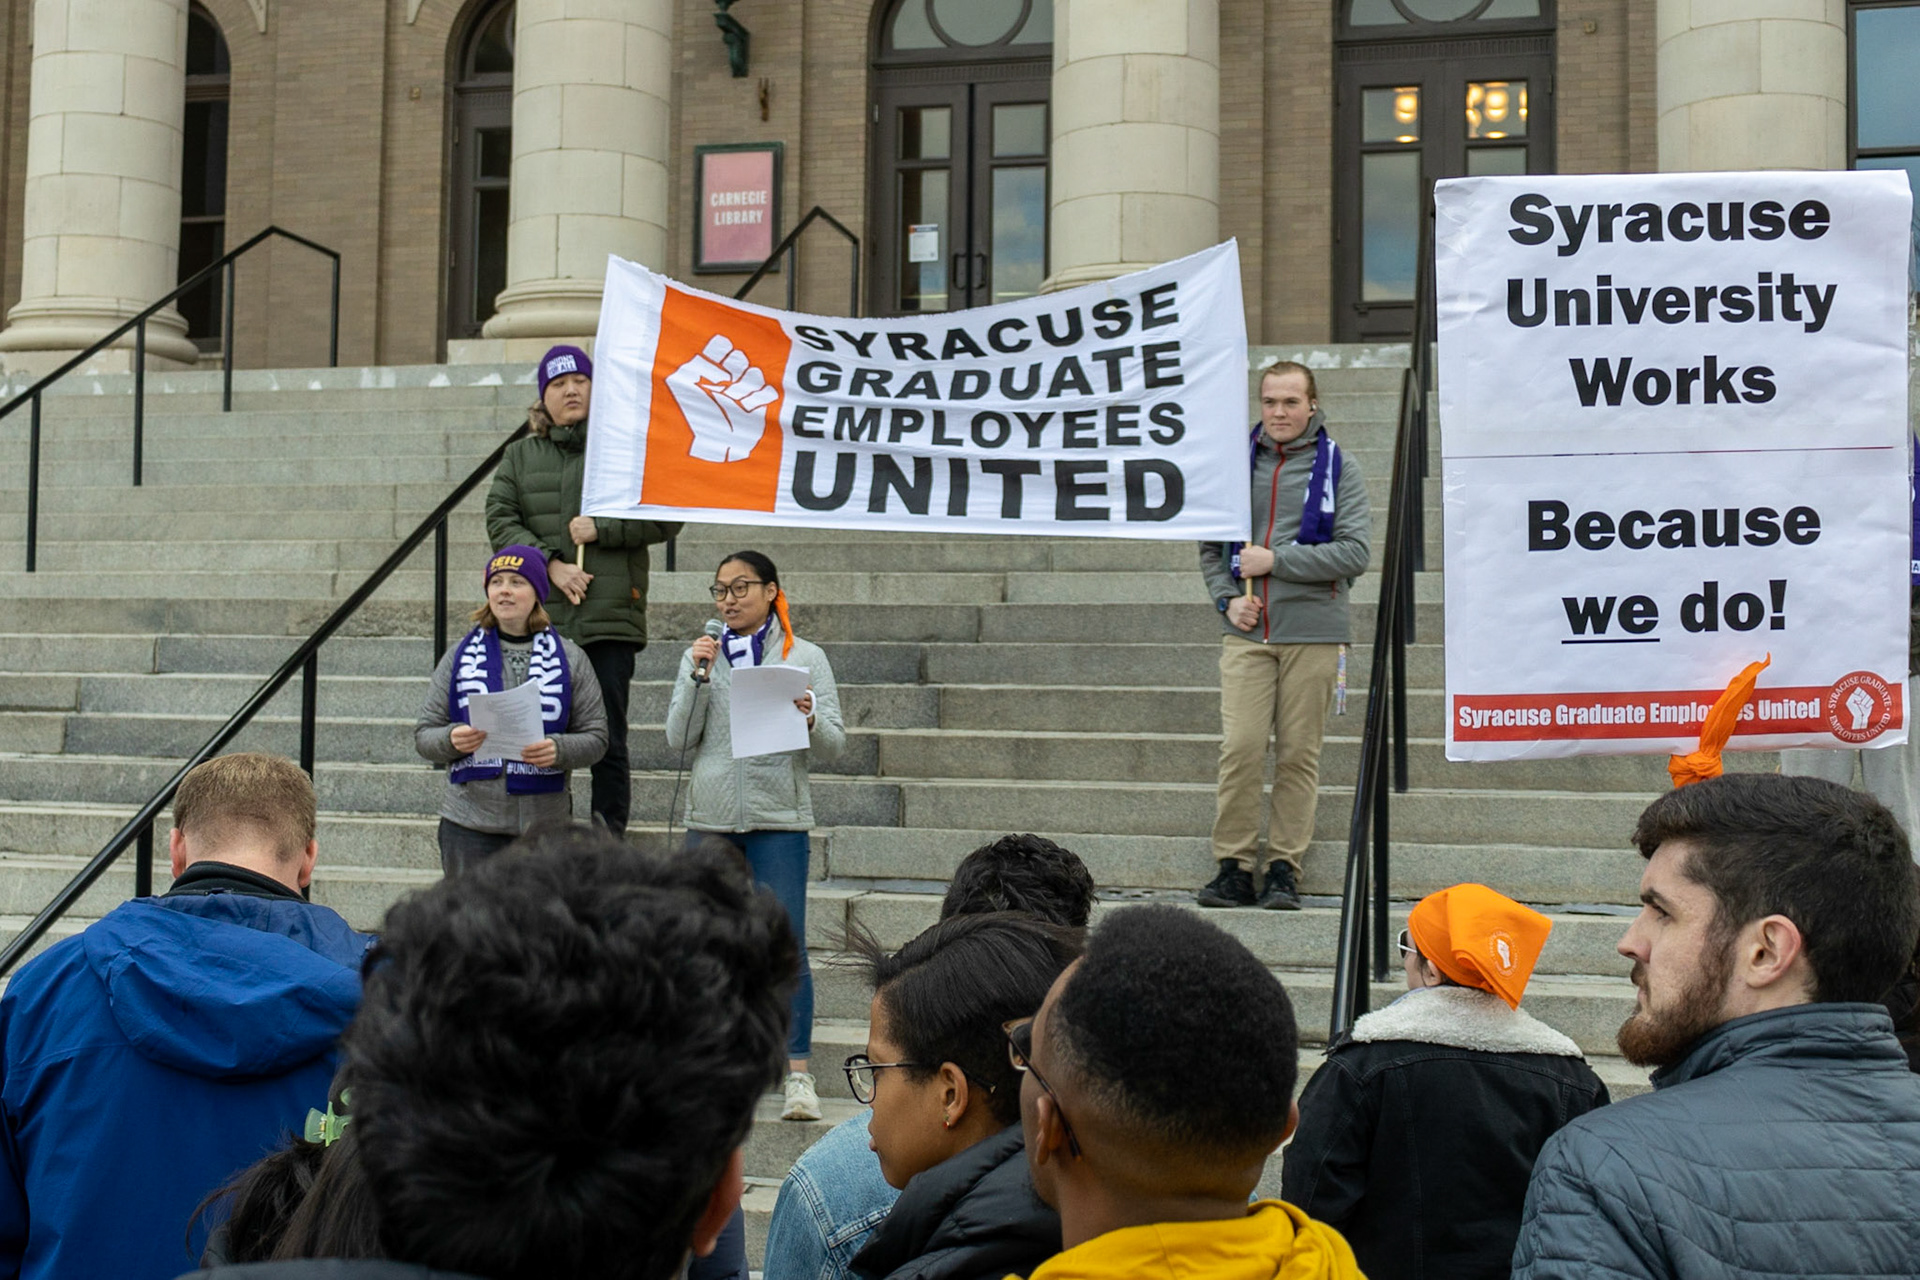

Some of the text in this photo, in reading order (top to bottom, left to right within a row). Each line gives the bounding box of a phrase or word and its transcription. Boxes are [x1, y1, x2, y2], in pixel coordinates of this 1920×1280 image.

[711, 190, 768, 207] CARNEGIE
[714, 209, 763, 226] LIBRARY
[1508, 194, 1830, 256] Syracuse
[795, 282, 1179, 361] SYRACUSE
[1508, 272, 1837, 333] University
[797, 341, 1184, 400] GRADUATE
[1569, 356, 1776, 406] Works
[792, 403, 1185, 448] EMPLOYEES
[792, 451, 1185, 522] UNITED
[1529, 500, 1820, 551] Because
[1562, 580, 1788, 634] we do!
[1459, 698, 1820, 729] Syracuse Graduate Emplos United
[1828, 675, 1892, 709] SYRACUSE GRADUATE
[1829, 713, 1891, 740] EMPLOYEES UNITED
